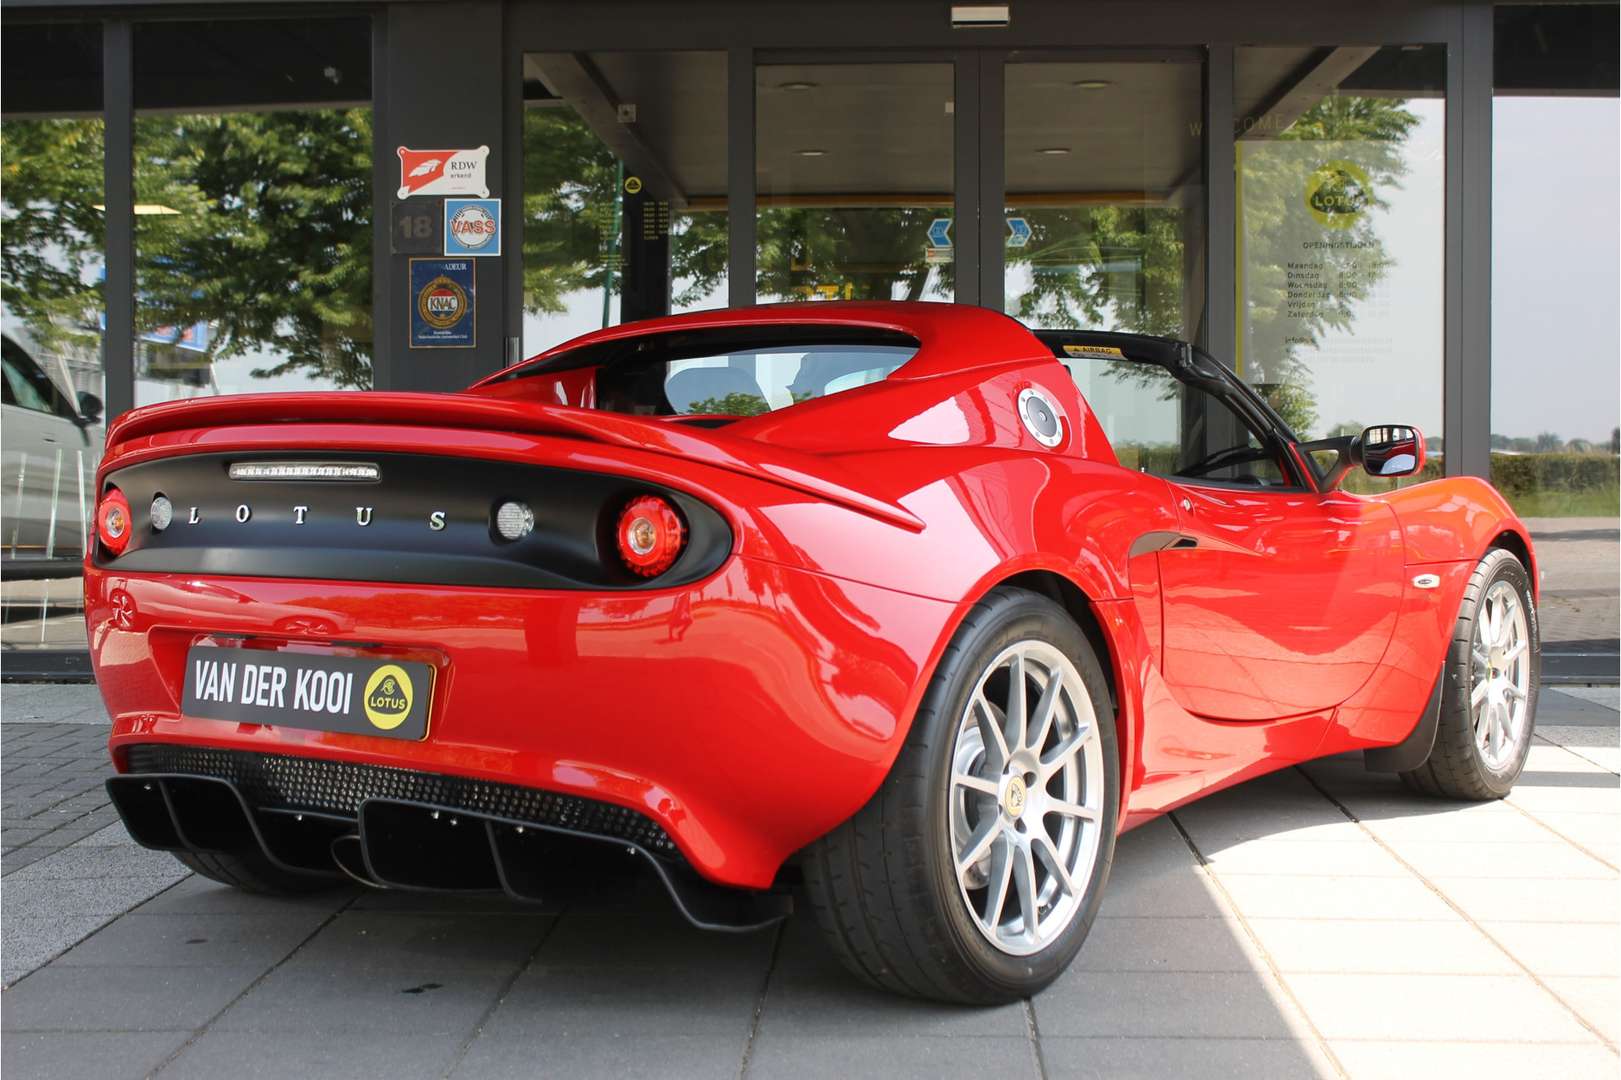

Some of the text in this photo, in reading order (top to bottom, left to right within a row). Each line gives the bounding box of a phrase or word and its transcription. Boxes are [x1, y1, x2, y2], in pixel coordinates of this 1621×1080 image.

[451, 161, 477, 170] RDW
[400, 215, 433, 239] 18
[450, 219, 496, 235] VASS
[430, 297, 457, 310] KNAC
[188, 503, 446, 532] LOTUS
[195, 660, 353, 715] VAN DER KOOI
[370, 694, 406, 710] LOTUS
